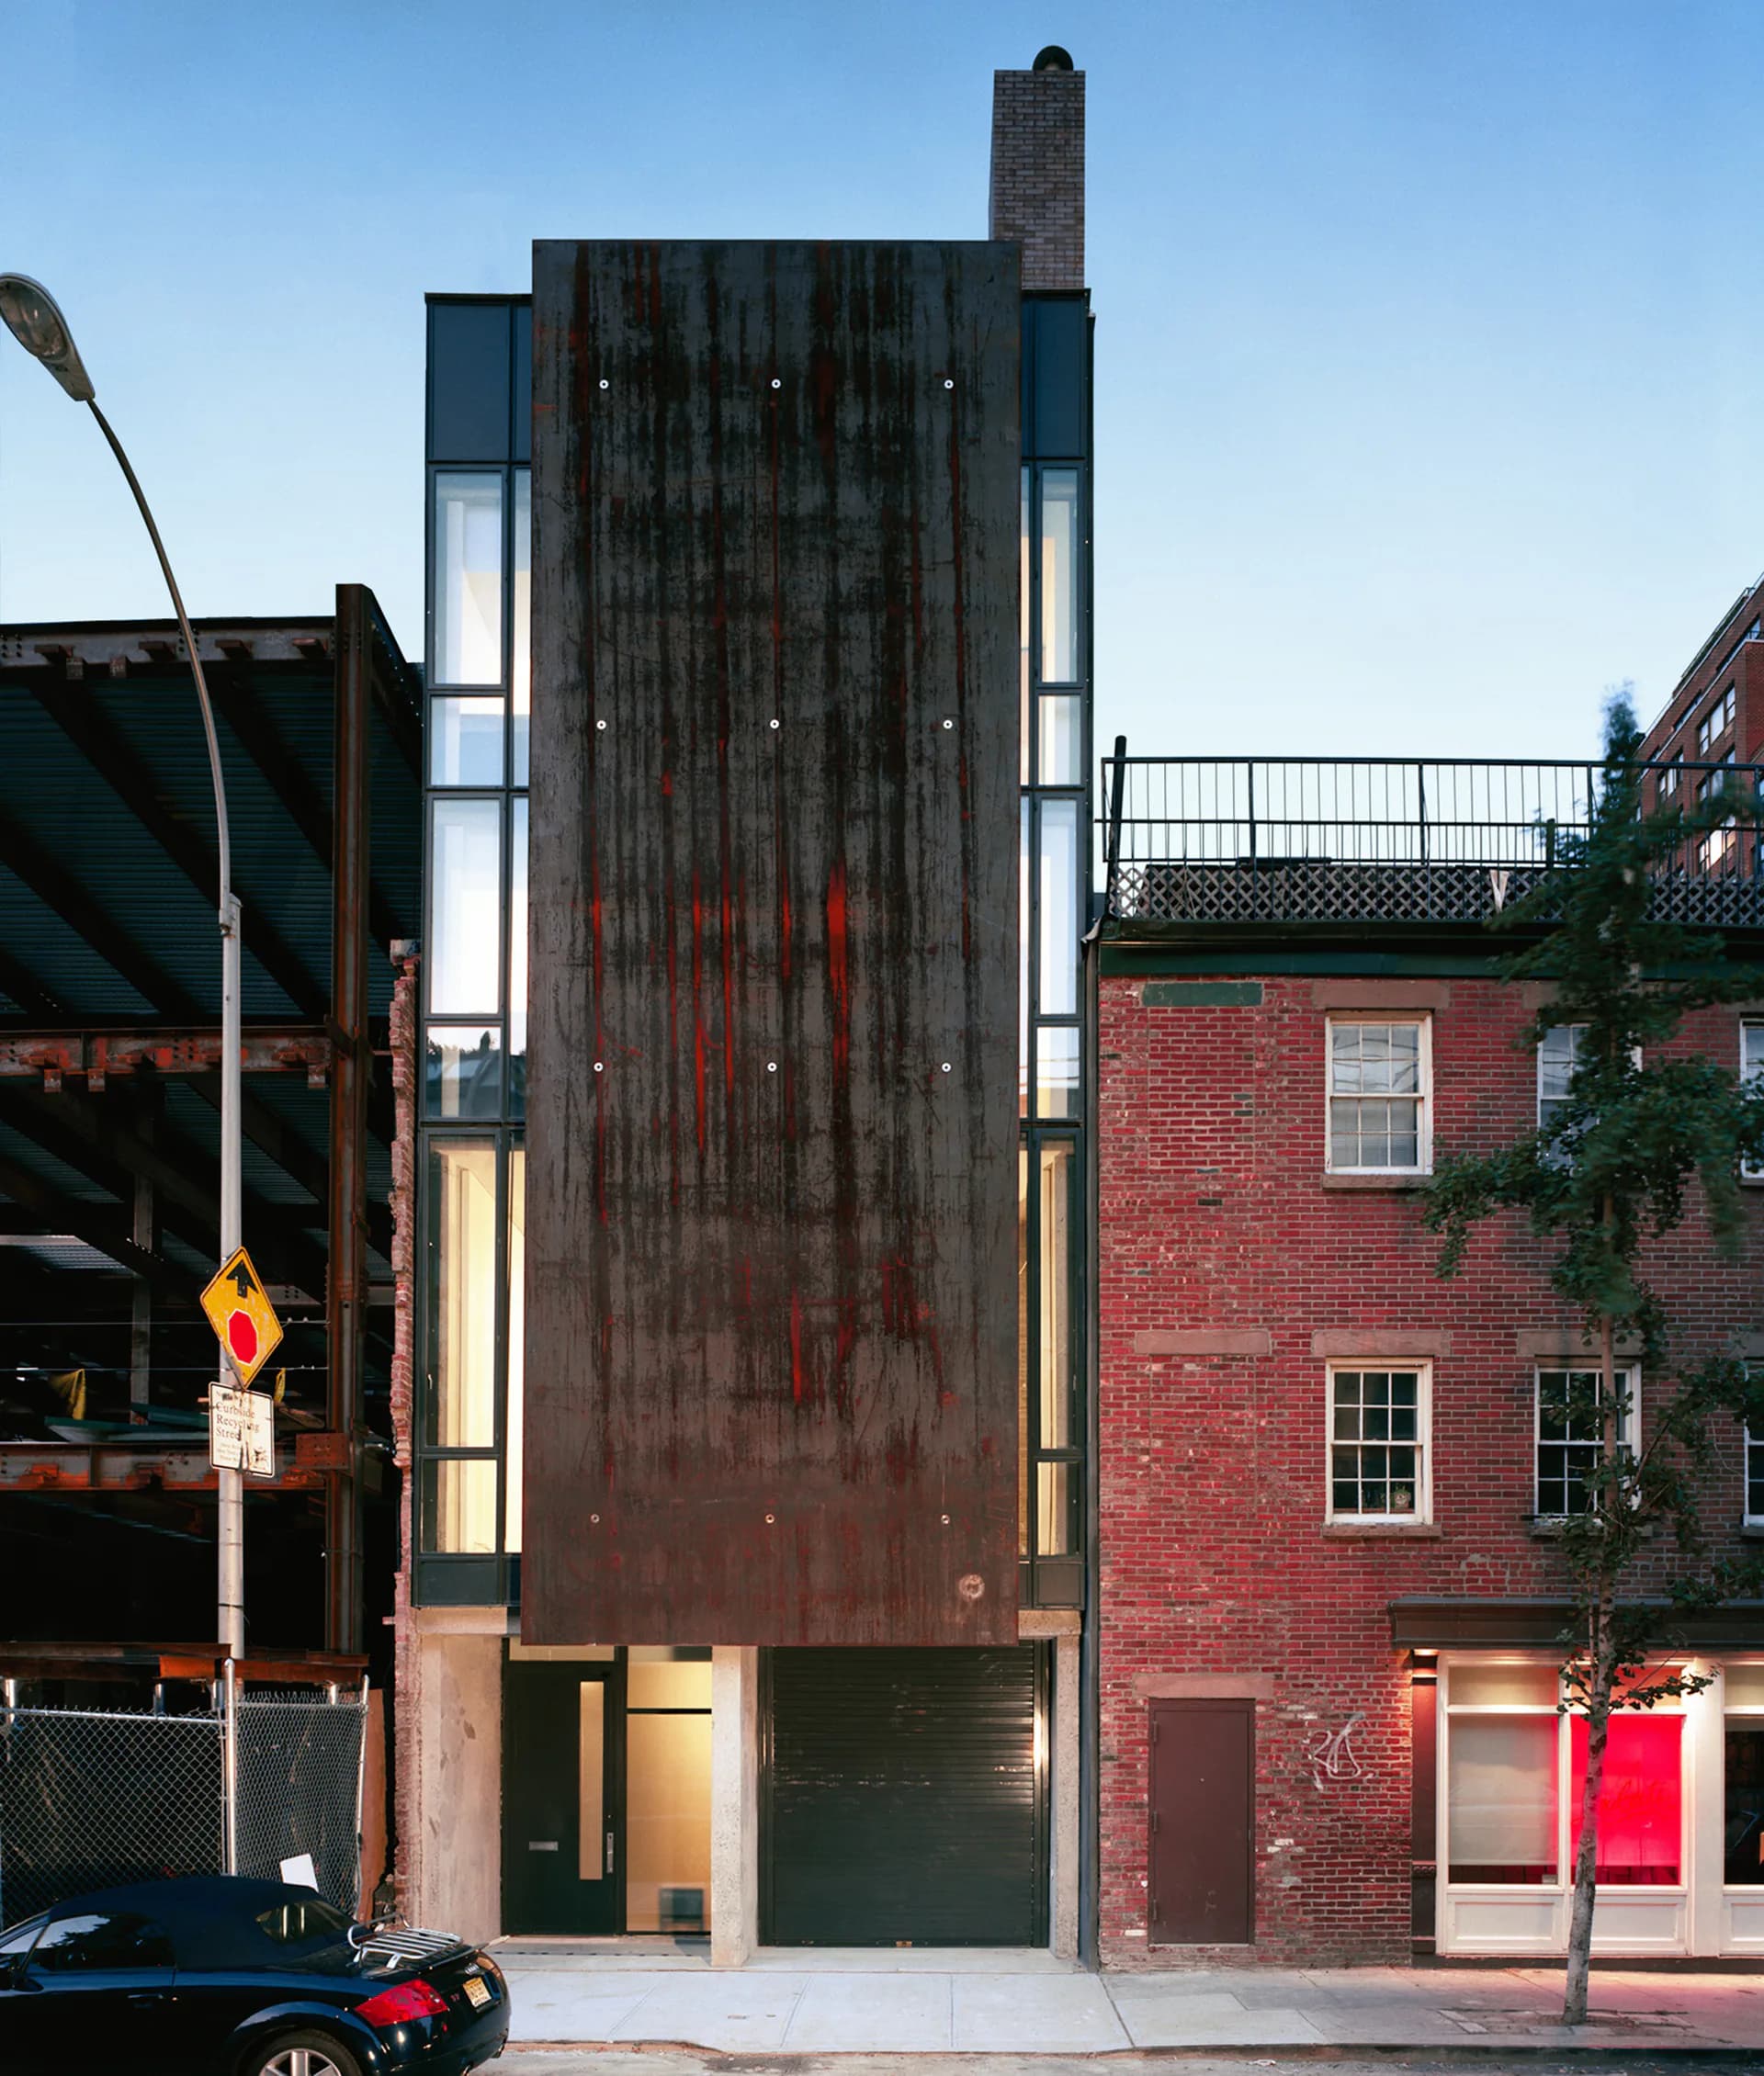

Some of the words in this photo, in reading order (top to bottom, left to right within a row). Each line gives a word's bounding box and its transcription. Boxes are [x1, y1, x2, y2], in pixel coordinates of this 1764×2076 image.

[216, 1401, 255, 1418] Curbside
[216, 1414, 260, 1434] Recycling
[216, 1426, 243, 1440] Stree
